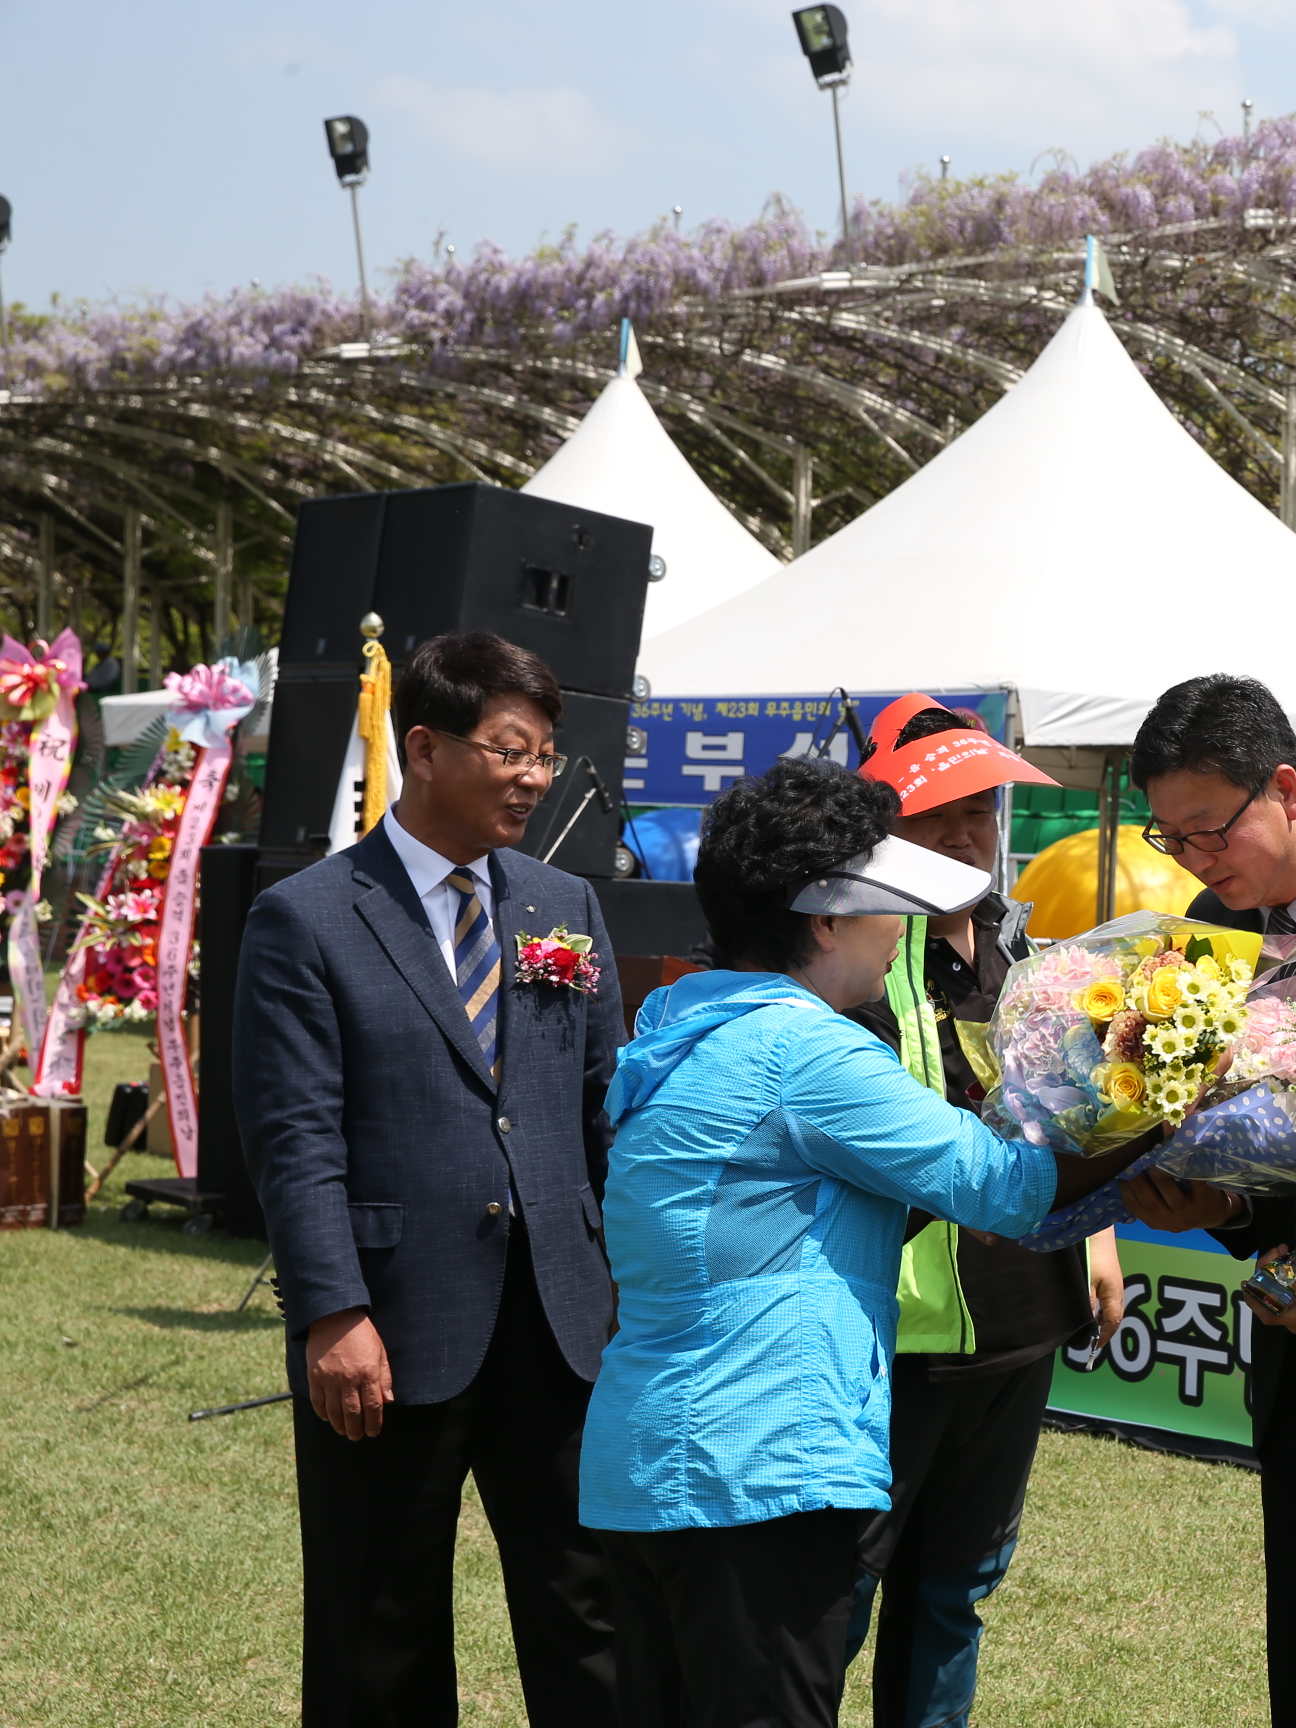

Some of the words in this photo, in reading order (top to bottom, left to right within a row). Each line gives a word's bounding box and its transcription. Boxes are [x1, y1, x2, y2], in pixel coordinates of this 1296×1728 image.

[630, 702, 673, 721] 36주년
[899, 775, 928, 801] 23회
[1064, 1276, 1252, 1414] 6주
